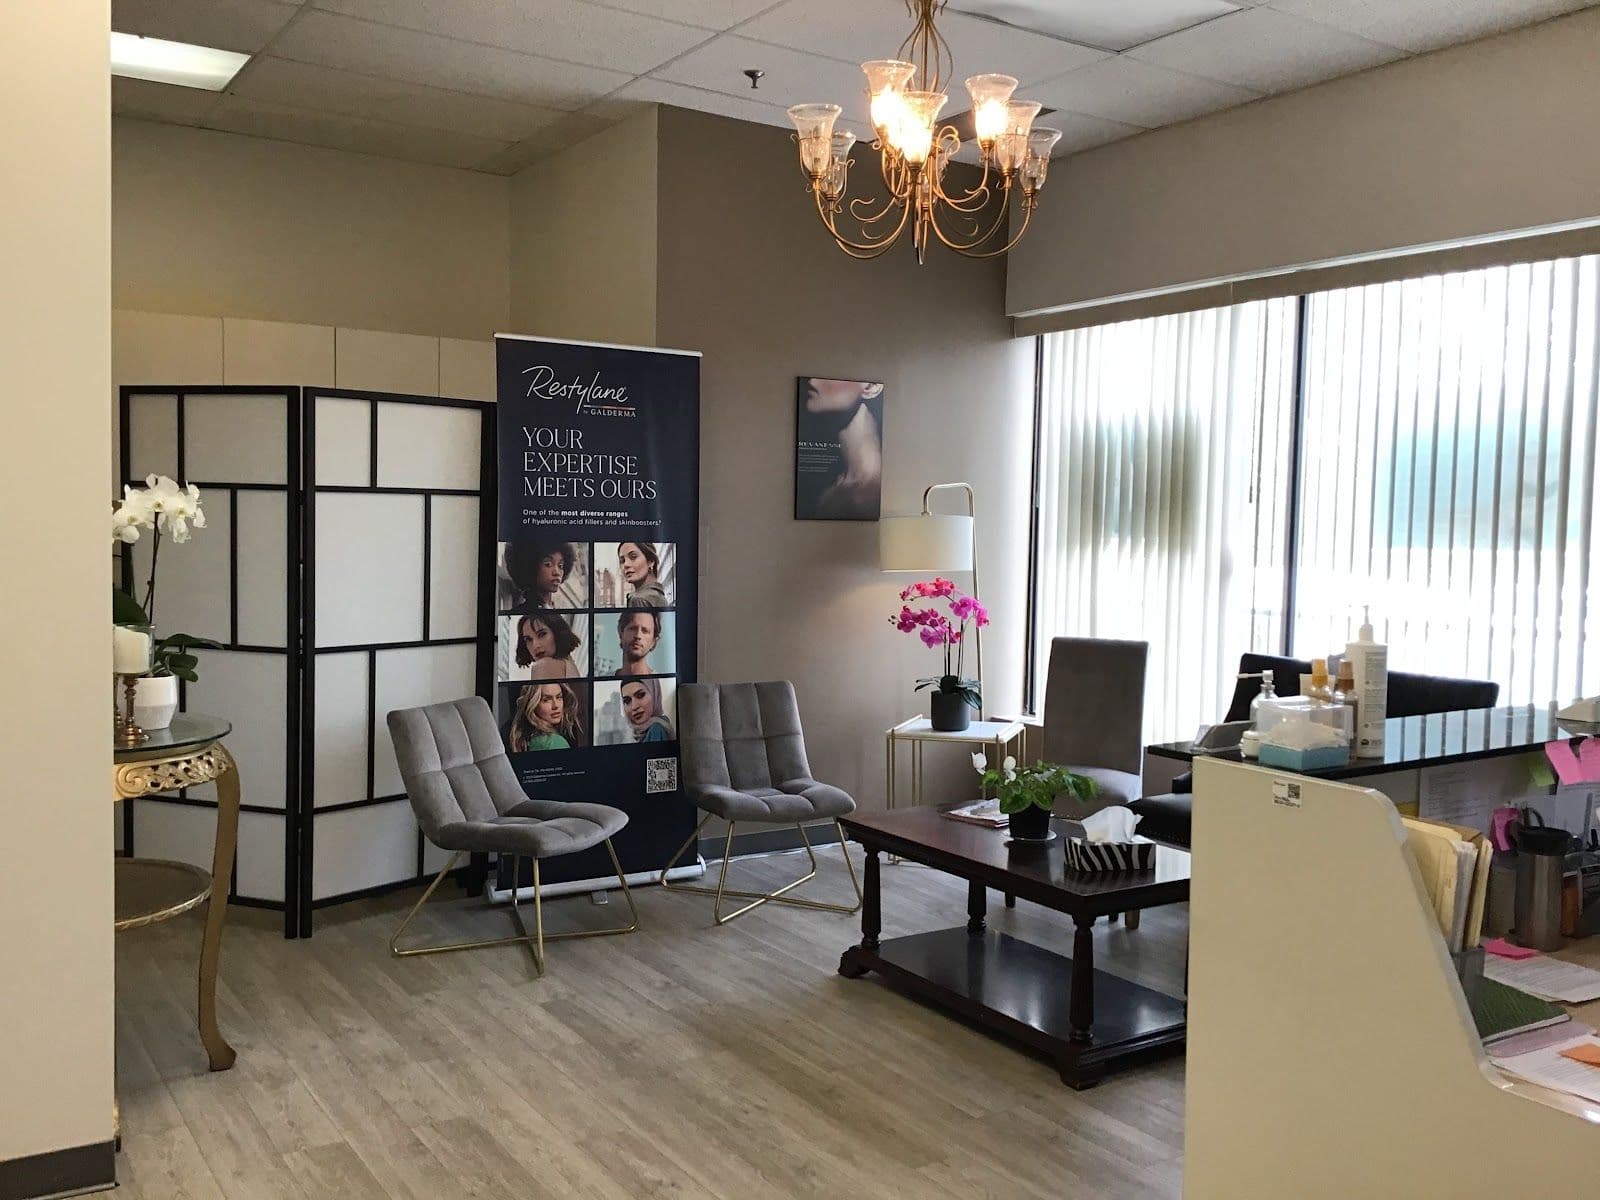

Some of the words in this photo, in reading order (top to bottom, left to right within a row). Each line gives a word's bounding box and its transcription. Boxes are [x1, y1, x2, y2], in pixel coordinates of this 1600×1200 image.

[522, 365, 629, 415] Restylane
[590, 408, 636, 418] GALDERMA
[523, 426, 583, 449] YOUR
[524, 451, 638, 475] EXPERTISE
[524, 476, 595, 498] MEETS
[600, 478, 657, 500] OURS
[522, 508, 538, 517] One
[539, 508, 547, 517] of
[548, 509, 560, 517] the
[561, 509, 578, 518] most
[580, 509, 605, 519] diverse
[606, 511, 629, 519] ranges
[522, 517, 531, 525] of
[532, 517, 568, 527] hyaluronic
[569, 518, 584, 526] acid
[585, 518, 604, 526] fillers
